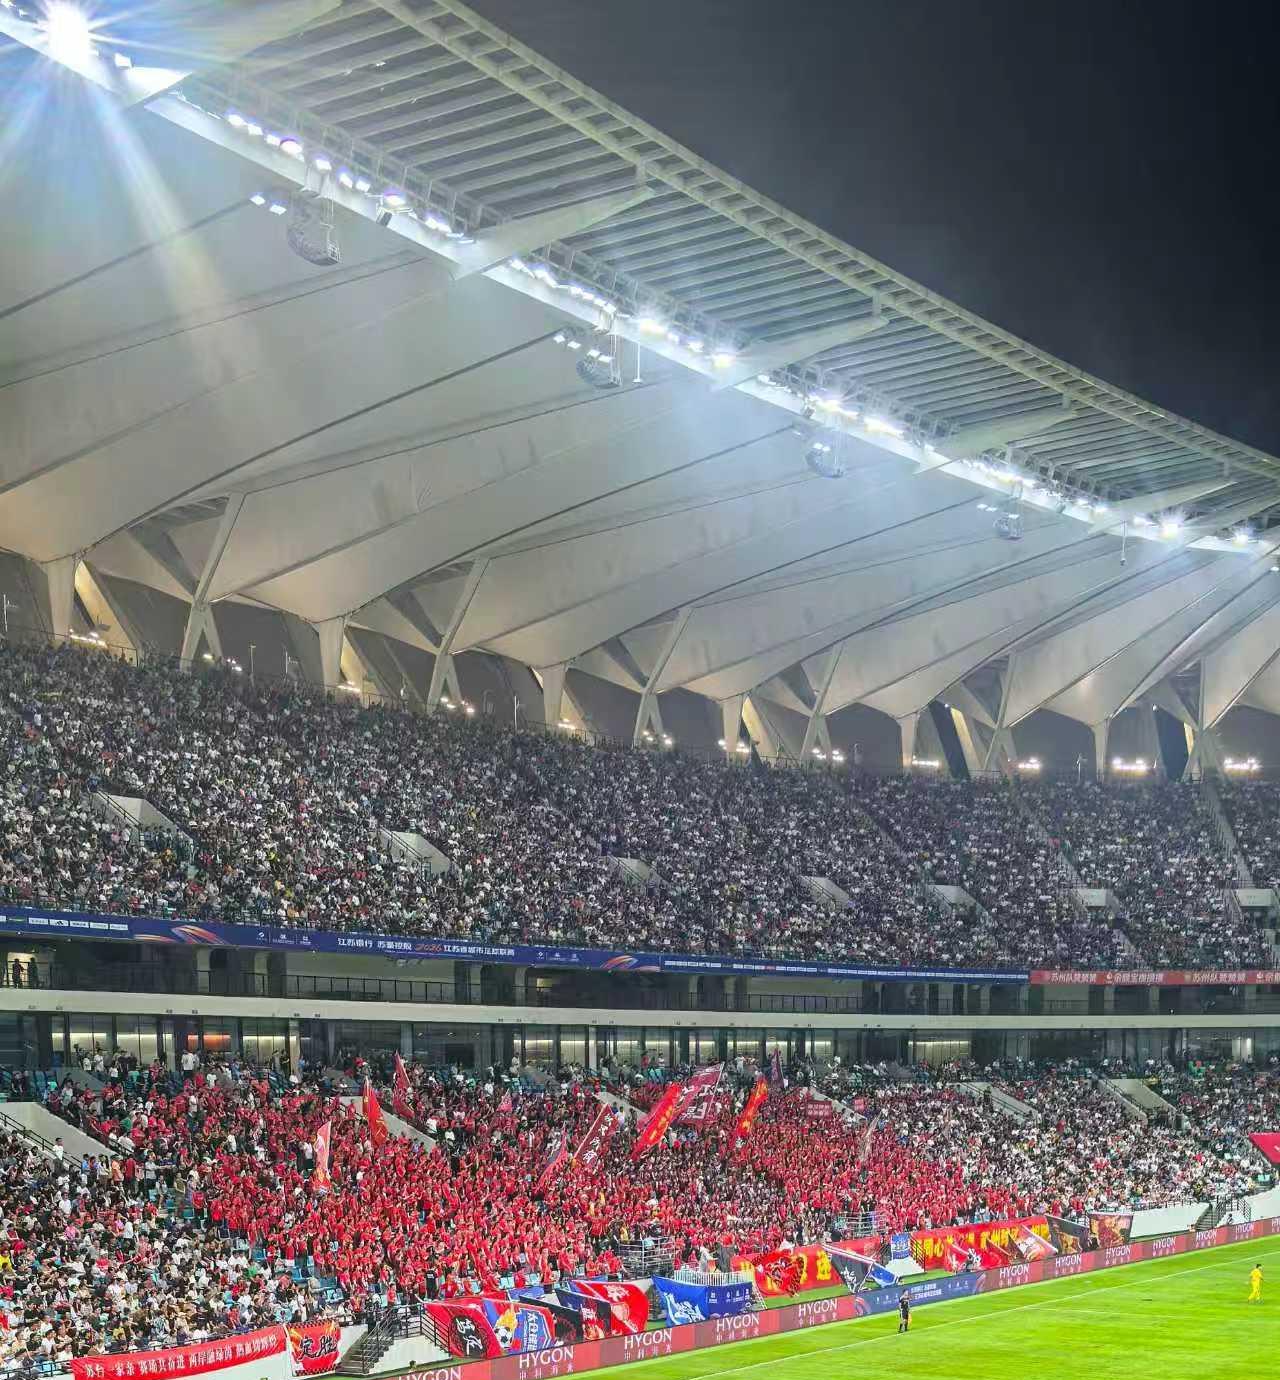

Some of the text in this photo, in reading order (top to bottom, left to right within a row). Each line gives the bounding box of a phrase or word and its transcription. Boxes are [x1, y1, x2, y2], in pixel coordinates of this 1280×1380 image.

[1055, 1253, 1082, 1268] HYGON
[1106, 1244, 1132, 1258] HYGON
[999, 1263, 1030, 1279] HYGON
[798, 1298, 838, 1317] HYGON
[717, 1312, 760, 1332] HYGON
[624, 1328, 673, 1349] HYGON
[519, 1345, 574, 1369] HYGON
